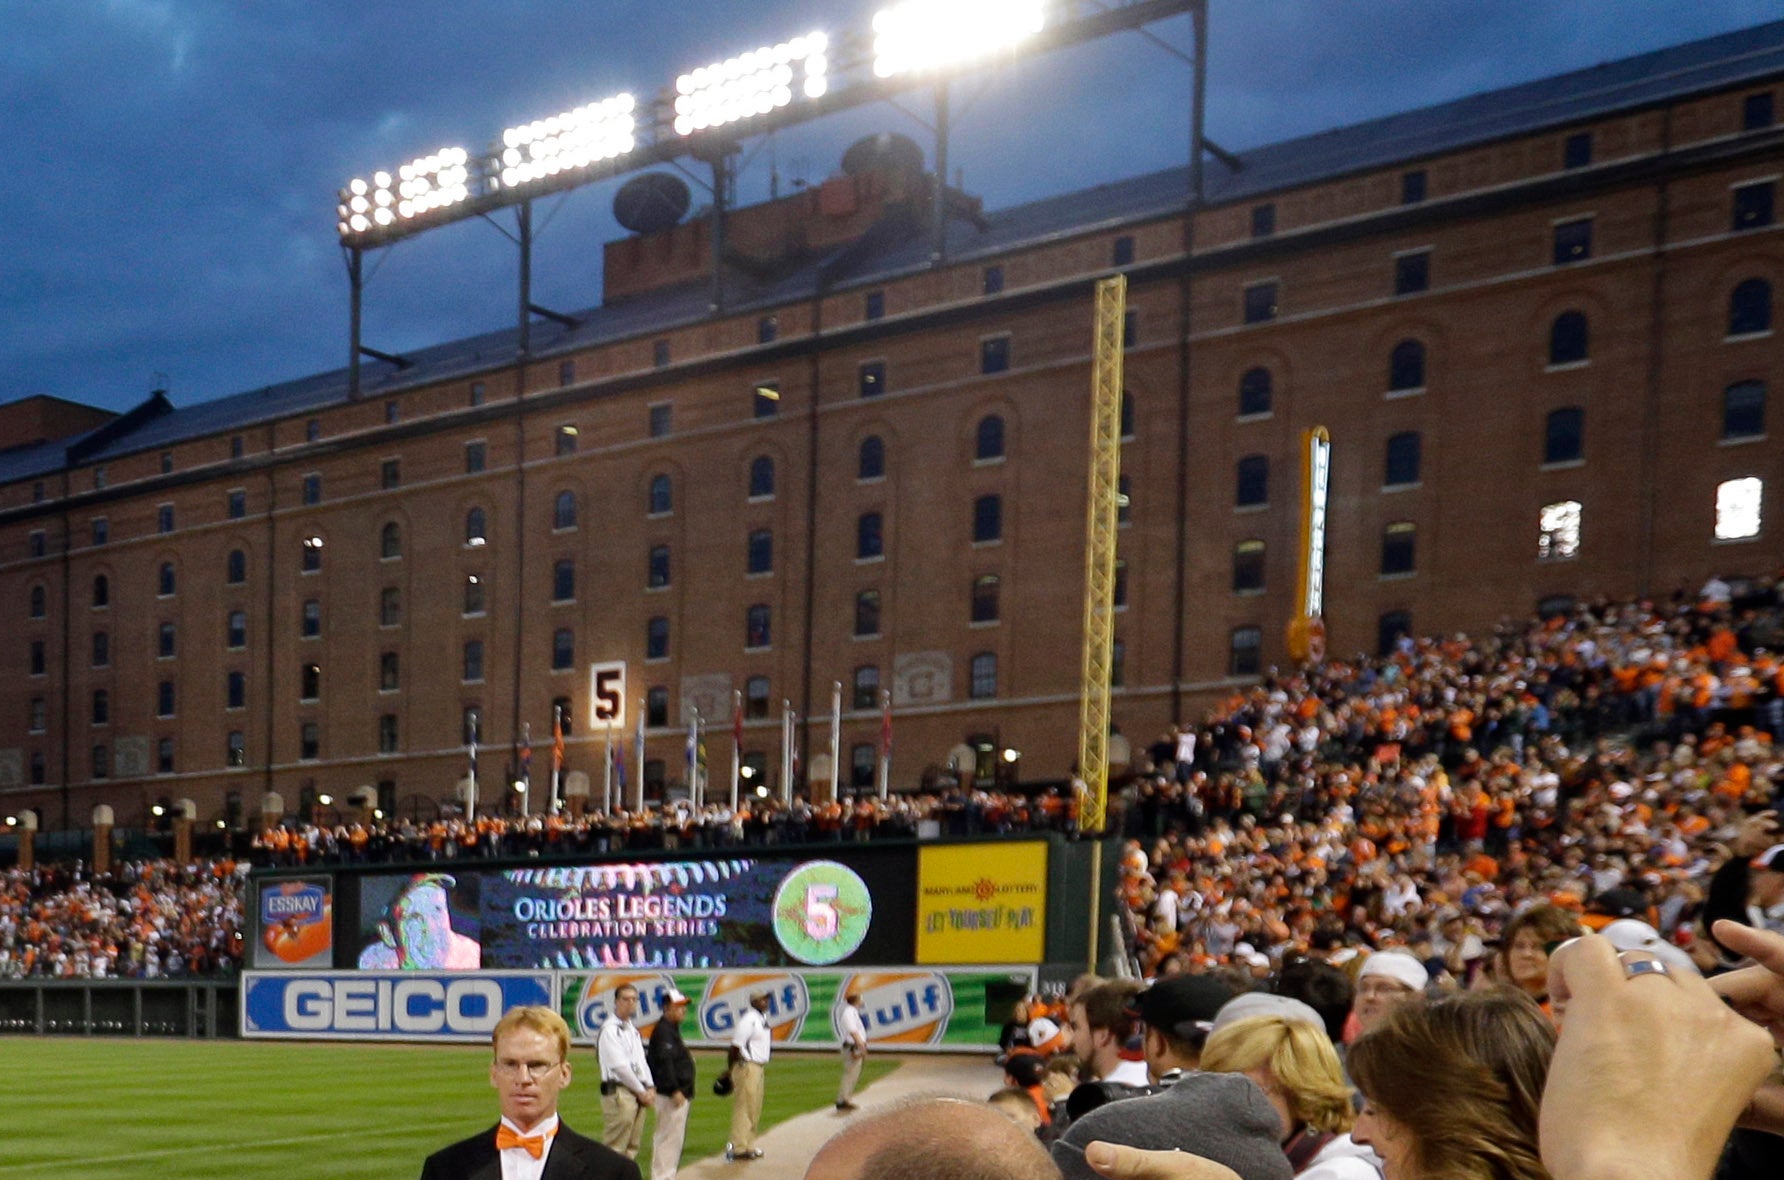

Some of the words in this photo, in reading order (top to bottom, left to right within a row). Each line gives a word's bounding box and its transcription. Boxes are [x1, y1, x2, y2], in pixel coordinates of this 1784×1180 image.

[595, 669, 622, 720] 5
[268, 895, 318, 913] ESSKAY
[515, 897, 610, 922] ORIOLES
[617, 894, 727, 920] LEGENDS
[805, 883, 839, 941] 5
[283, 979, 504, 1031] GEICO
[584, 985, 667, 1030] Glf
[706, 984, 798, 1032] Glf
[860, 984, 940, 1032] ulf
